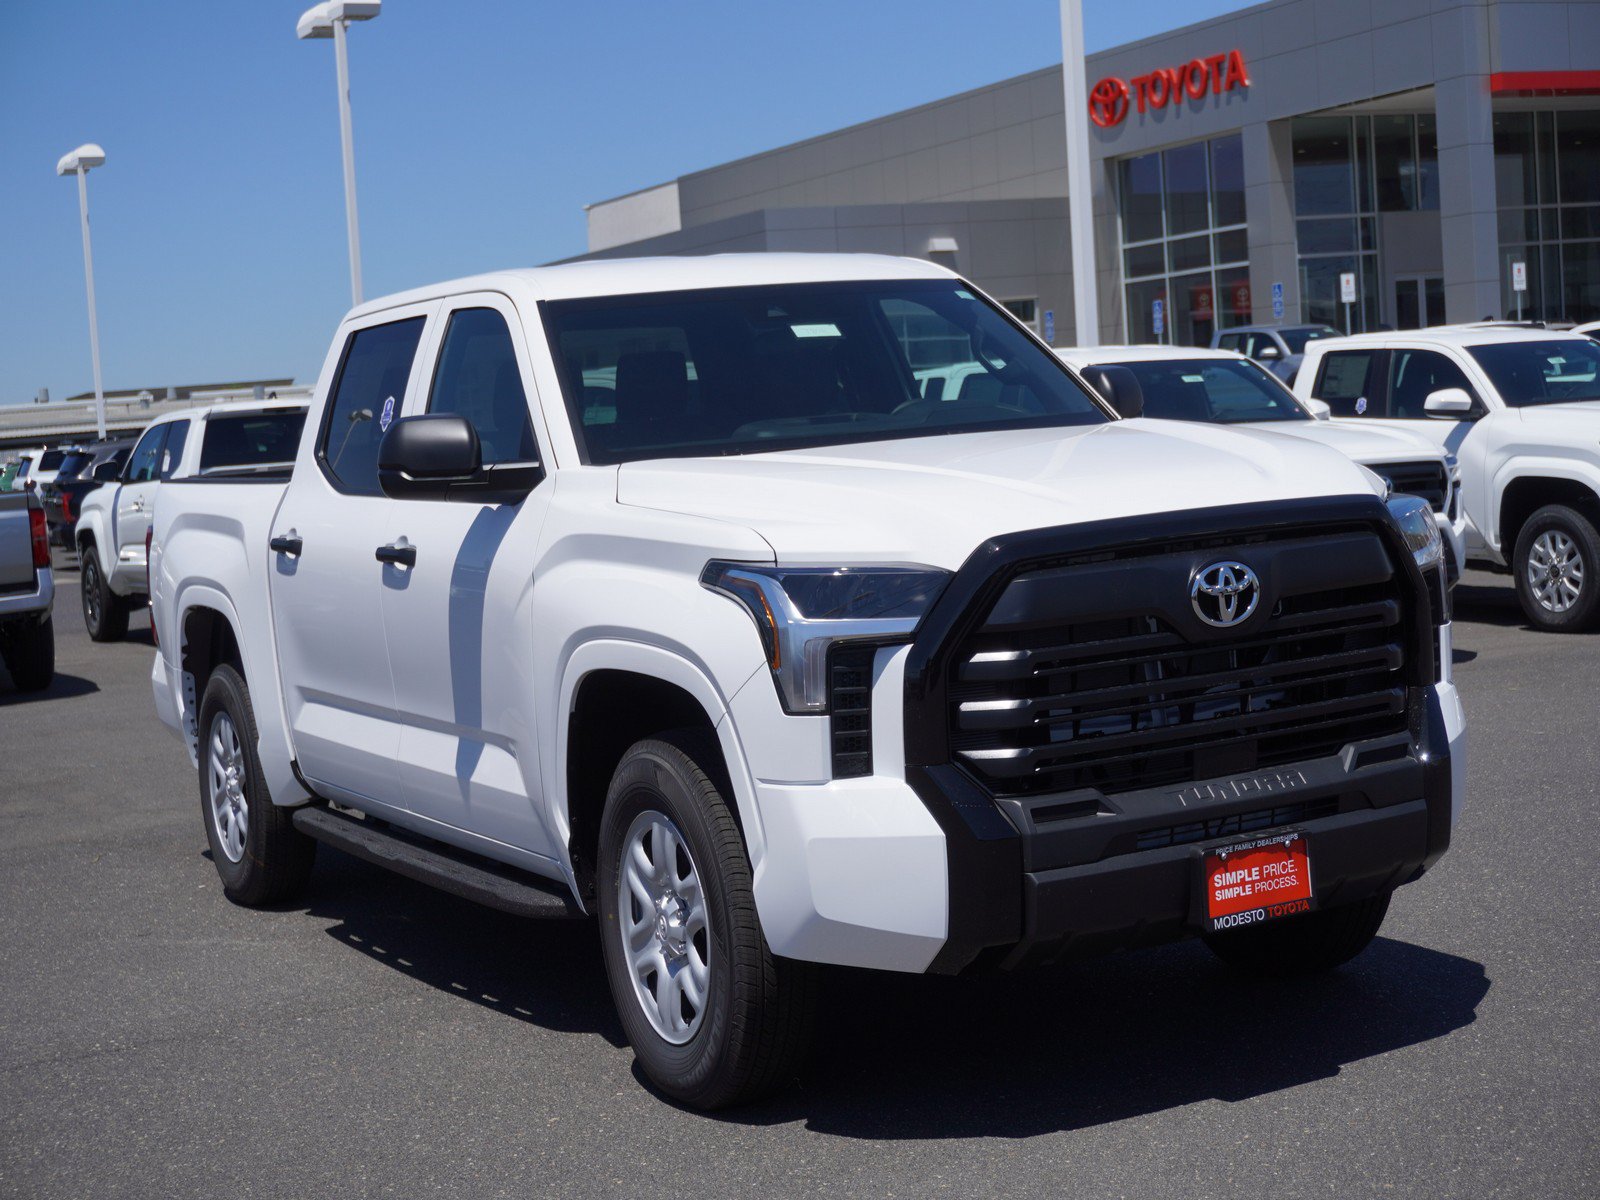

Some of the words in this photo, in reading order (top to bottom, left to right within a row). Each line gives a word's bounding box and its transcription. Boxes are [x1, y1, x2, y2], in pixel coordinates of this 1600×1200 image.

[1130, 49, 1250, 114] TOYOTA
[1165, 769, 1307, 807] TUNDRA
[1234, 841, 1256, 852] FAMILY
[1257, 833, 1299, 847] DEALERSHIPS
[1213, 867, 1260, 887] SIMPLE
[1262, 859, 1298, 878] PRICE.
[1214, 884, 1253, 901] SIMPLE
[1254, 875, 1300, 894] PROCESS.
[1213, 908, 1265, 930] MODESTO
[1267, 899, 1310, 918] TOYOTA
